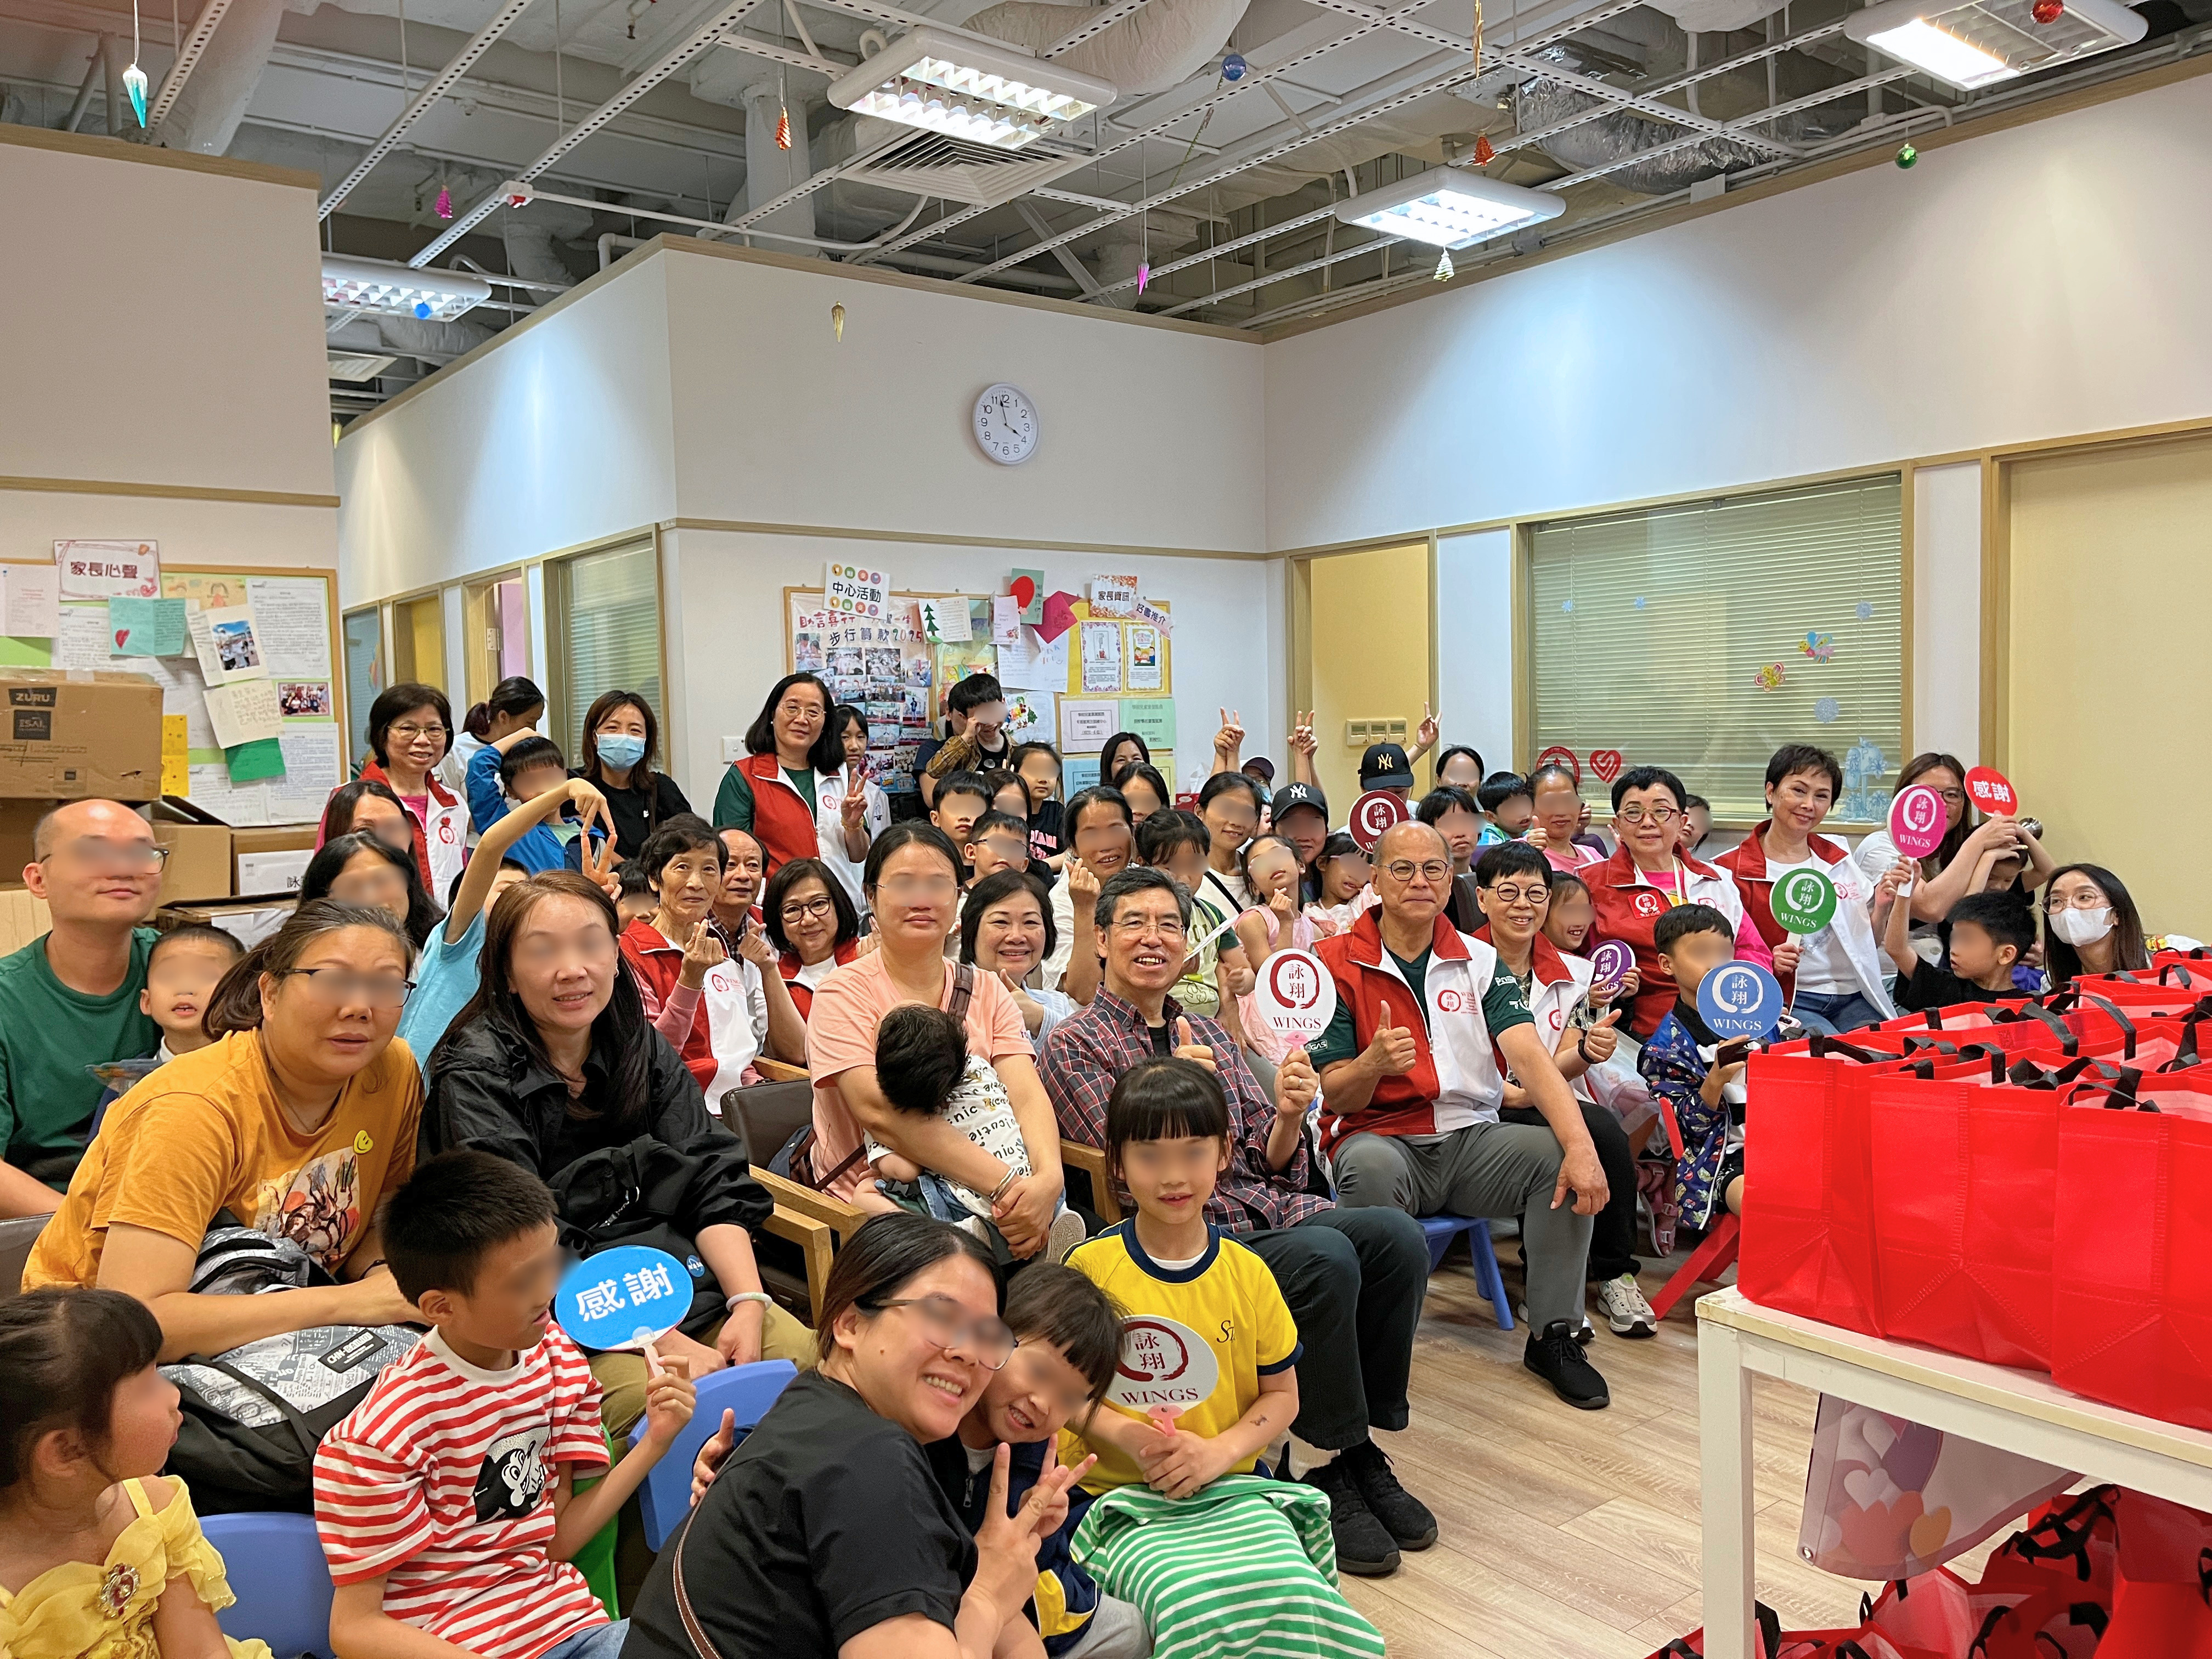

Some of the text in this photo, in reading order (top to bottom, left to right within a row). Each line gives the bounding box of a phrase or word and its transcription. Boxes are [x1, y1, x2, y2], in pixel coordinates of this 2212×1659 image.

[991, 396, 997, 404] 11
[1002, 394, 1009, 403] 12
[983, 405, 992, 414] 10
[1021, 409, 1027, 418] 2
[981, 417, 988, 426] 9
[1024, 423, 1030, 432] 3
[984, 431, 991, 440] 8
[993, 442, 998, 450] 7
[1002, 446, 1009, 455] 6
[1014, 444, 1020, 453] 5
[71, 561, 137, 579] 家長心聲
[833, 582, 881, 603] 中心活動
[1098, 591, 1130, 601] 家長資訊
[1136, 603, 1166, 625] 好書推介
[15, 692, 50, 702] ZURU
[1972, 780, 2011, 803] 感謝
[1373, 804, 1387, 828] 詠翔
[1899, 834, 1931, 848] WINGS
[1799, 880, 1815, 905] 詠翔
[1781, 912, 1817, 928] WINGS
[1288, 964, 1305, 998] 詠翔
[1731, 975, 1748, 1005] 詠翔
[1273, 1017, 1321, 1029] WINGS
[1713, 1018, 1762, 1030] WINGS
[575, 1262, 674, 1322] 感謝
[1132, 1332, 1165, 1370] 詠翔
[1121, 1388, 1199, 1404] WINGS
